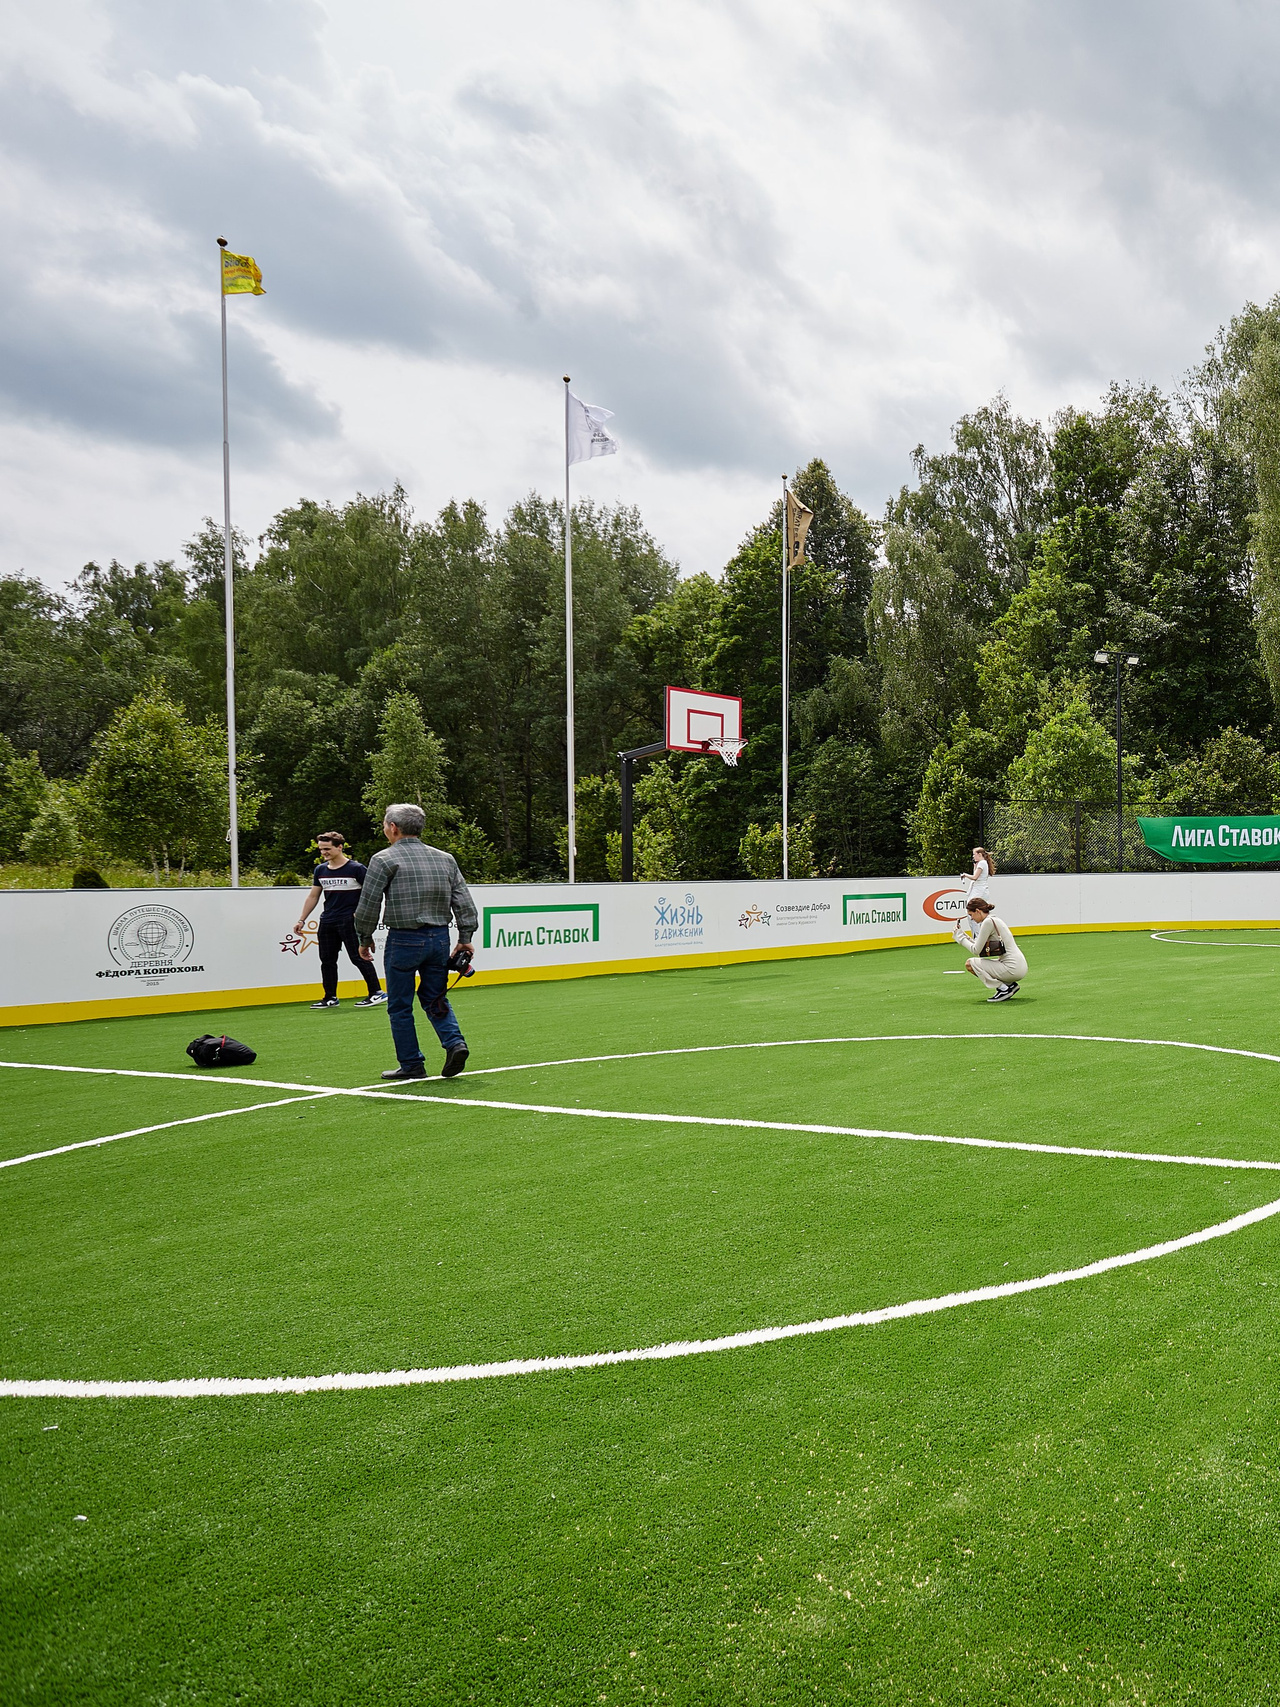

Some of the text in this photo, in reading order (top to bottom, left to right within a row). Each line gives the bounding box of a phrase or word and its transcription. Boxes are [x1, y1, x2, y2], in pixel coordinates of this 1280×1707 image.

[775, 902, 831, 913] Созвездие Добра
[935, 900, 968, 911] СТАЛ
[112, 916, 128, 936] ШКОЛА
[130, 960, 174, 969] ДЕРЕВНЯ
[95, 965, 205, 978] ФЁДОРА КОНЮХОВА
